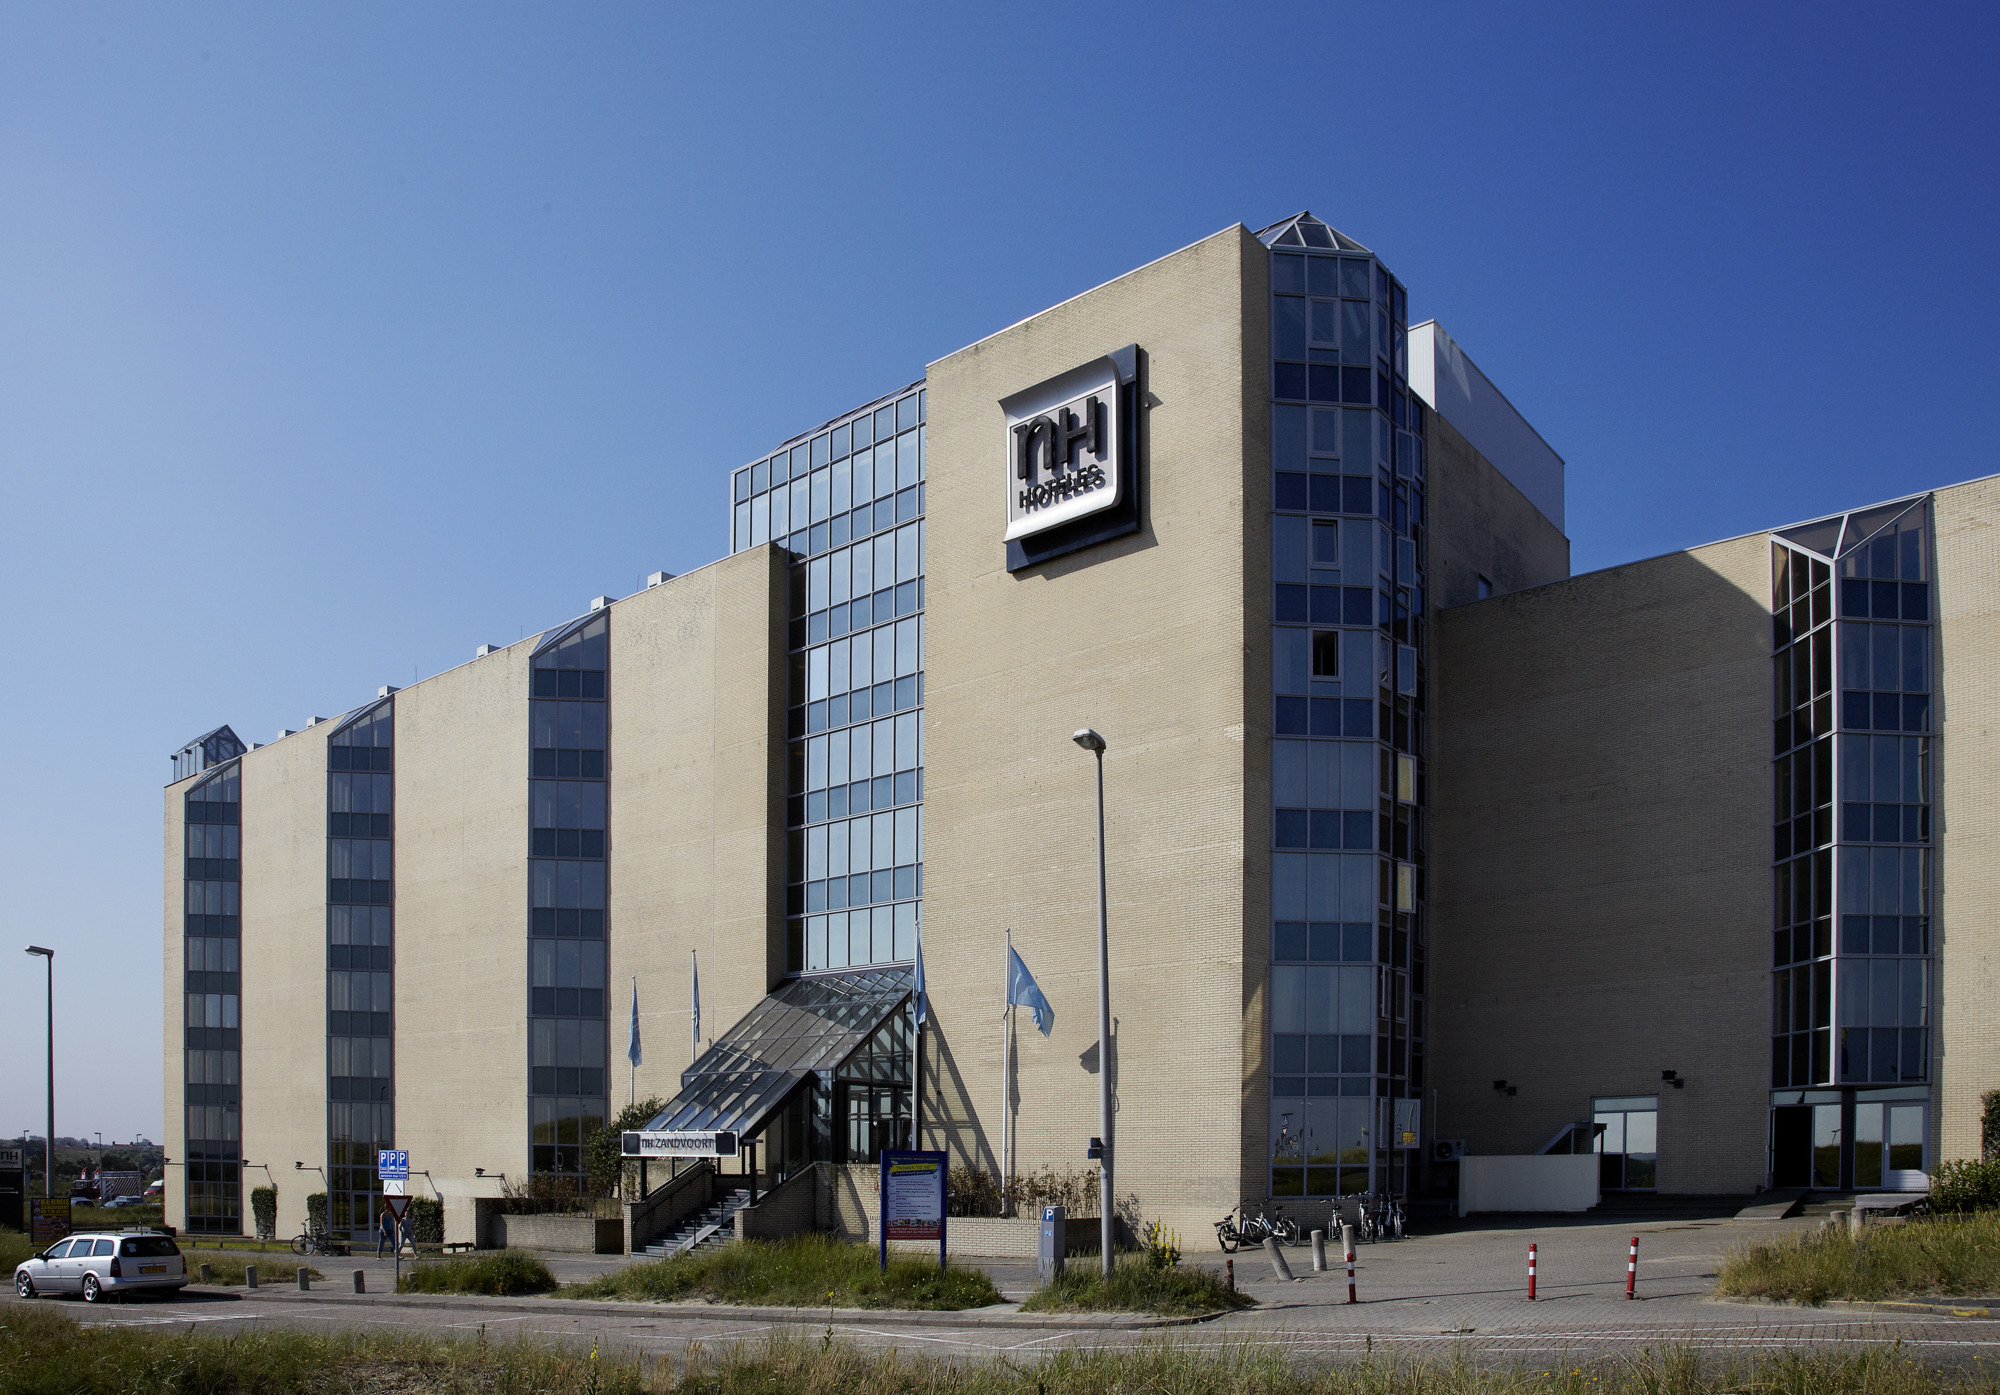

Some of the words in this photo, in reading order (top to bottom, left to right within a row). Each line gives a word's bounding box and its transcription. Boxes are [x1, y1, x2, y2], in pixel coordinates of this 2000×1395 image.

[1019, 464, 1101, 509] HOTELES
[655, 1138, 714, 1149] ZANDVOORT
[380, 1152, 386, 1163] P
[390, 1153, 395, 1163] P
[400, 1153, 405, 1164] P
[1046, 1209, 1053, 1220] P
